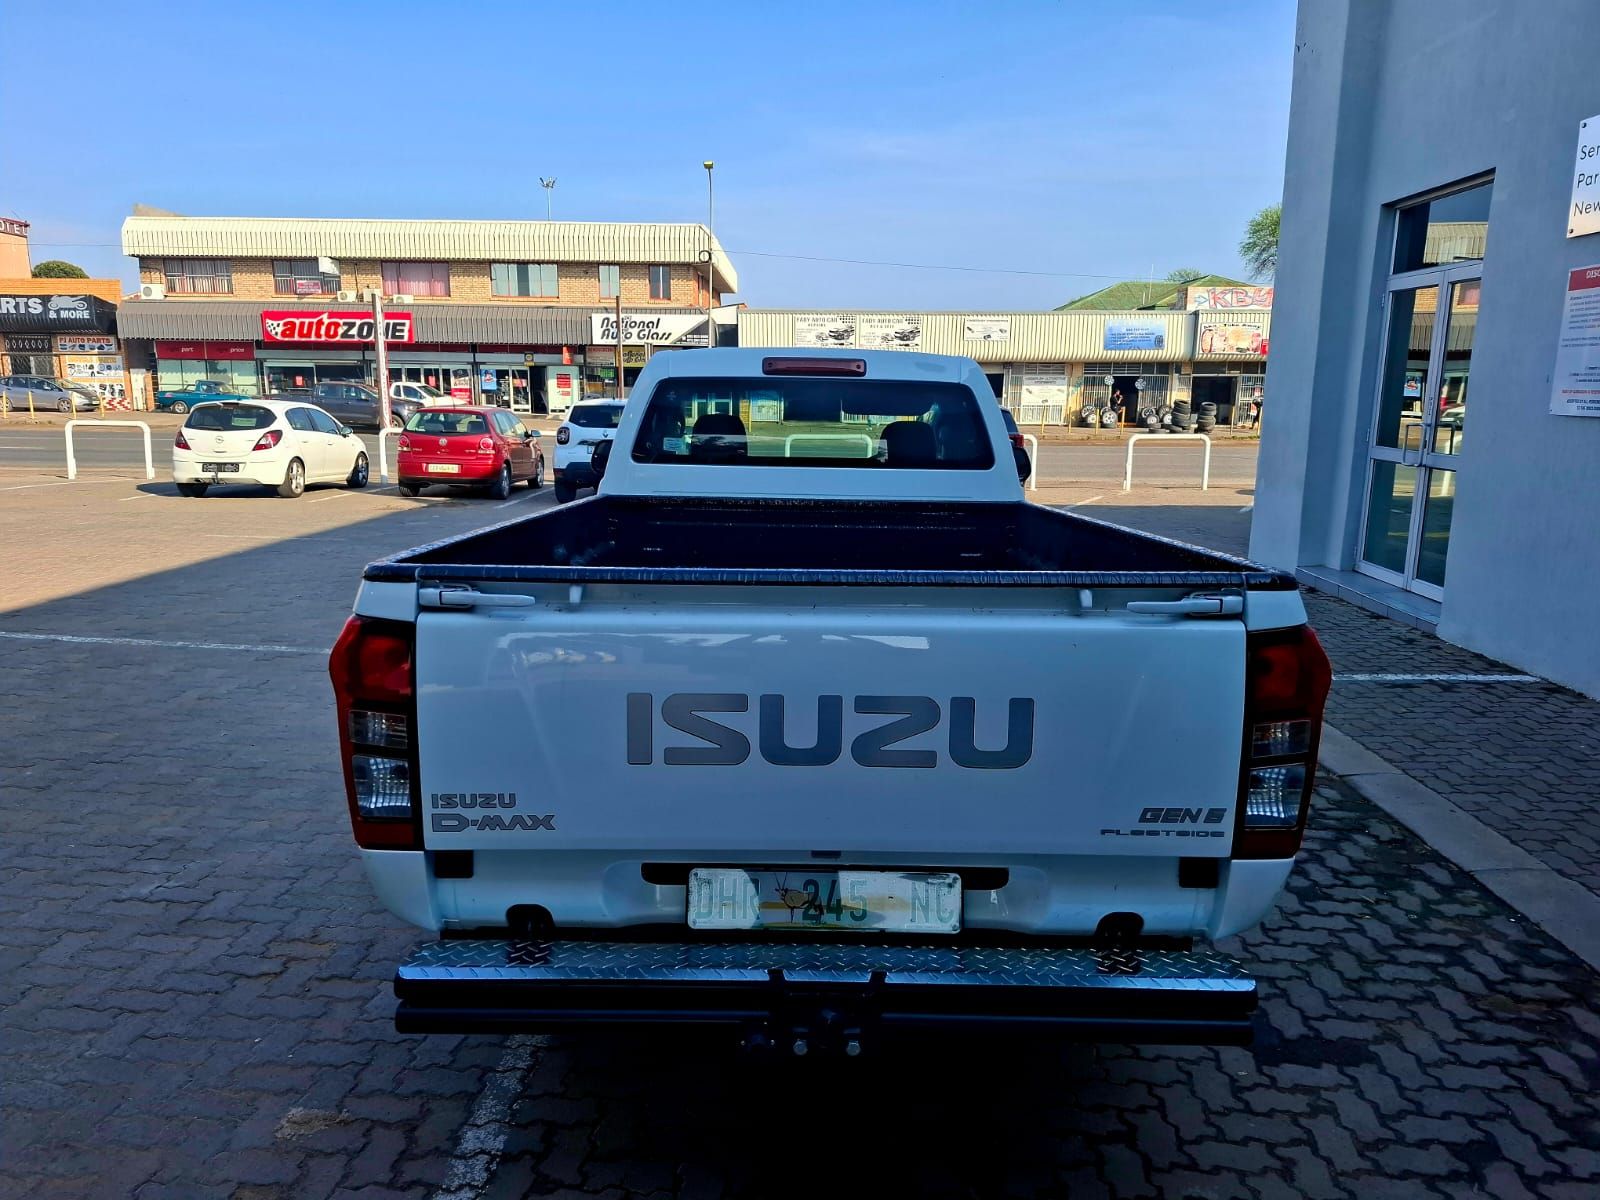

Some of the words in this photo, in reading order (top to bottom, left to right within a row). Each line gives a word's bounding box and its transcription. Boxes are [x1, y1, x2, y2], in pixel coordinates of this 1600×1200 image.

[1577, 172, 1600, 189] Par
[0, 298, 43, 314] RTS
[49, 310, 57, 319] &
[60, 310, 90, 319] MORE
[637, 329, 672, 340] Glass
[627, 692, 1035, 769] ISUZU
[431, 793, 517, 809] ISUZU
[431, 813, 556, 832] D-MAX
[1138, 808, 1203, 823] GEN
[1101, 829, 1225, 838] FLEETSIDE
[802, 878, 868, 923] 245
